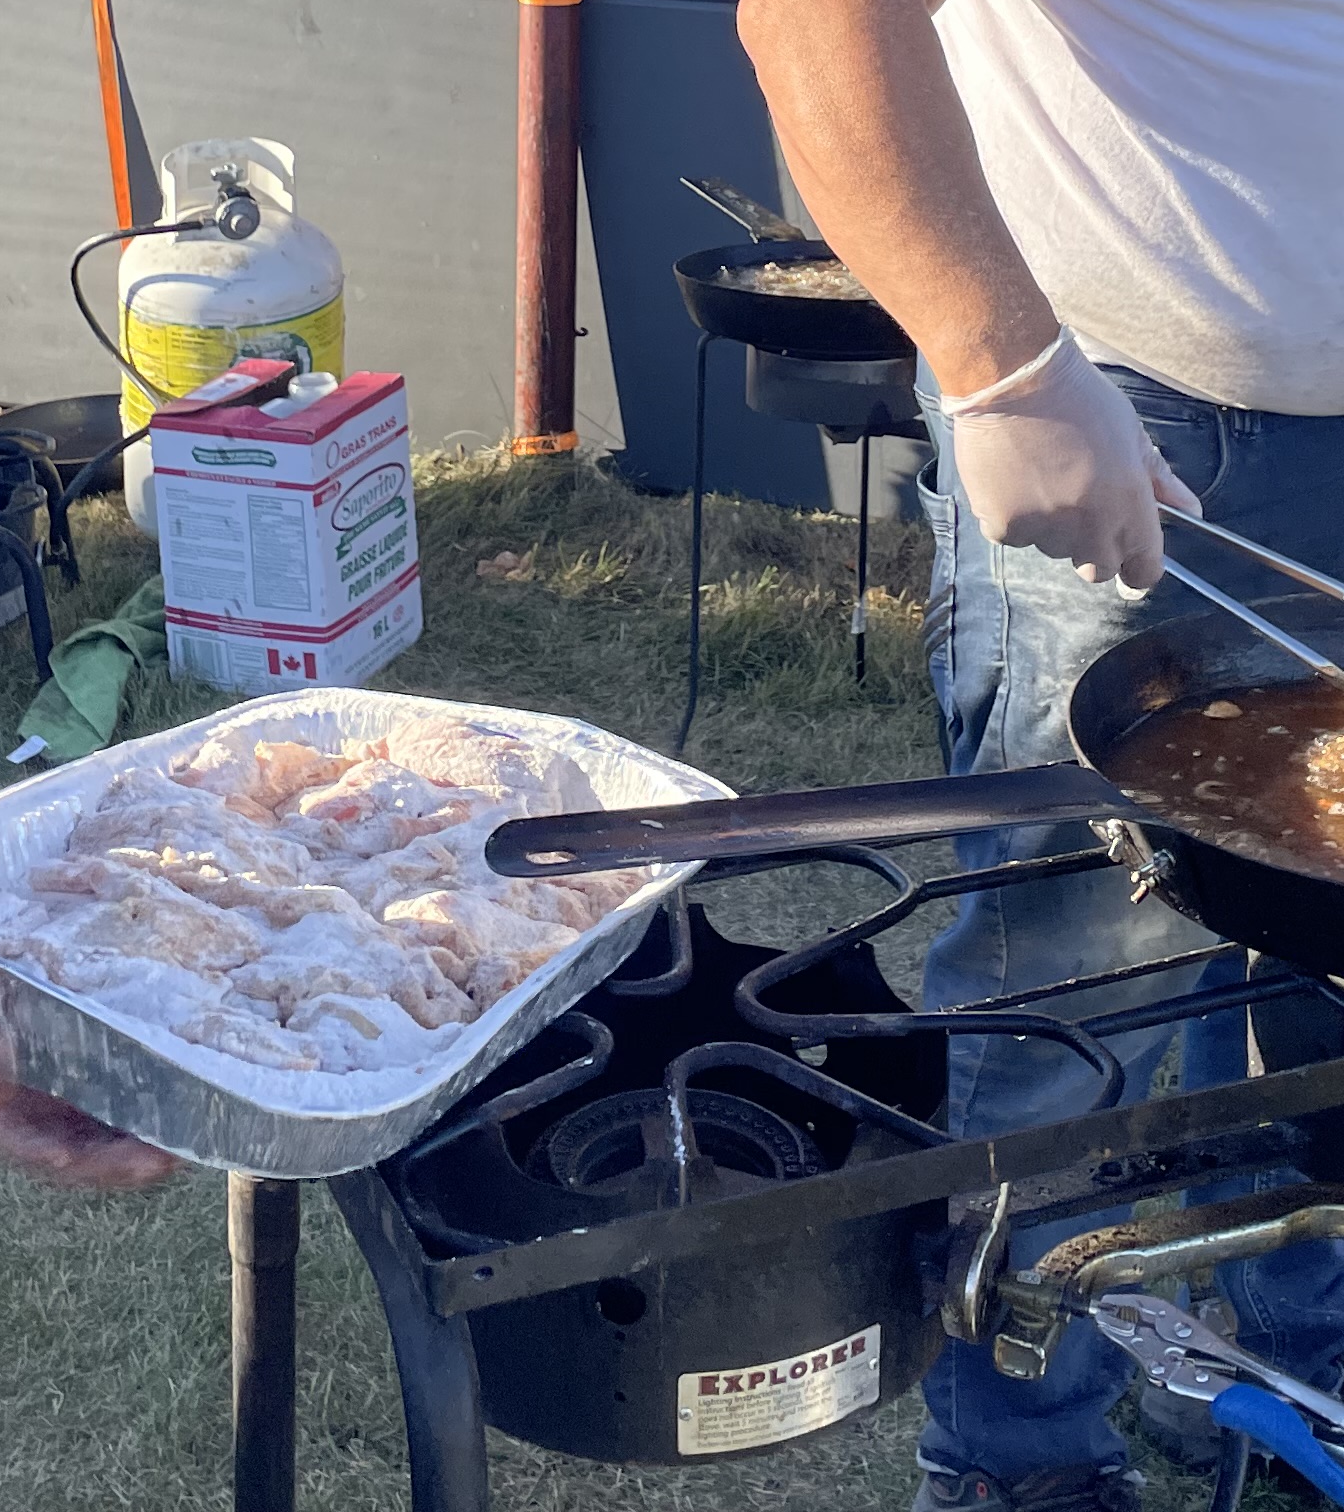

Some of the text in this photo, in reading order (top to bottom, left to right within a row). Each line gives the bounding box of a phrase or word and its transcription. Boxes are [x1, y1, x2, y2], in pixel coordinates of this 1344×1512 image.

[341, 435, 367, 459] GRAS
[367, 415, 397, 443] TRANS
[342, 473, 397, 521] Saporito
[698, 1336, 866, 1396] EXPLORER
